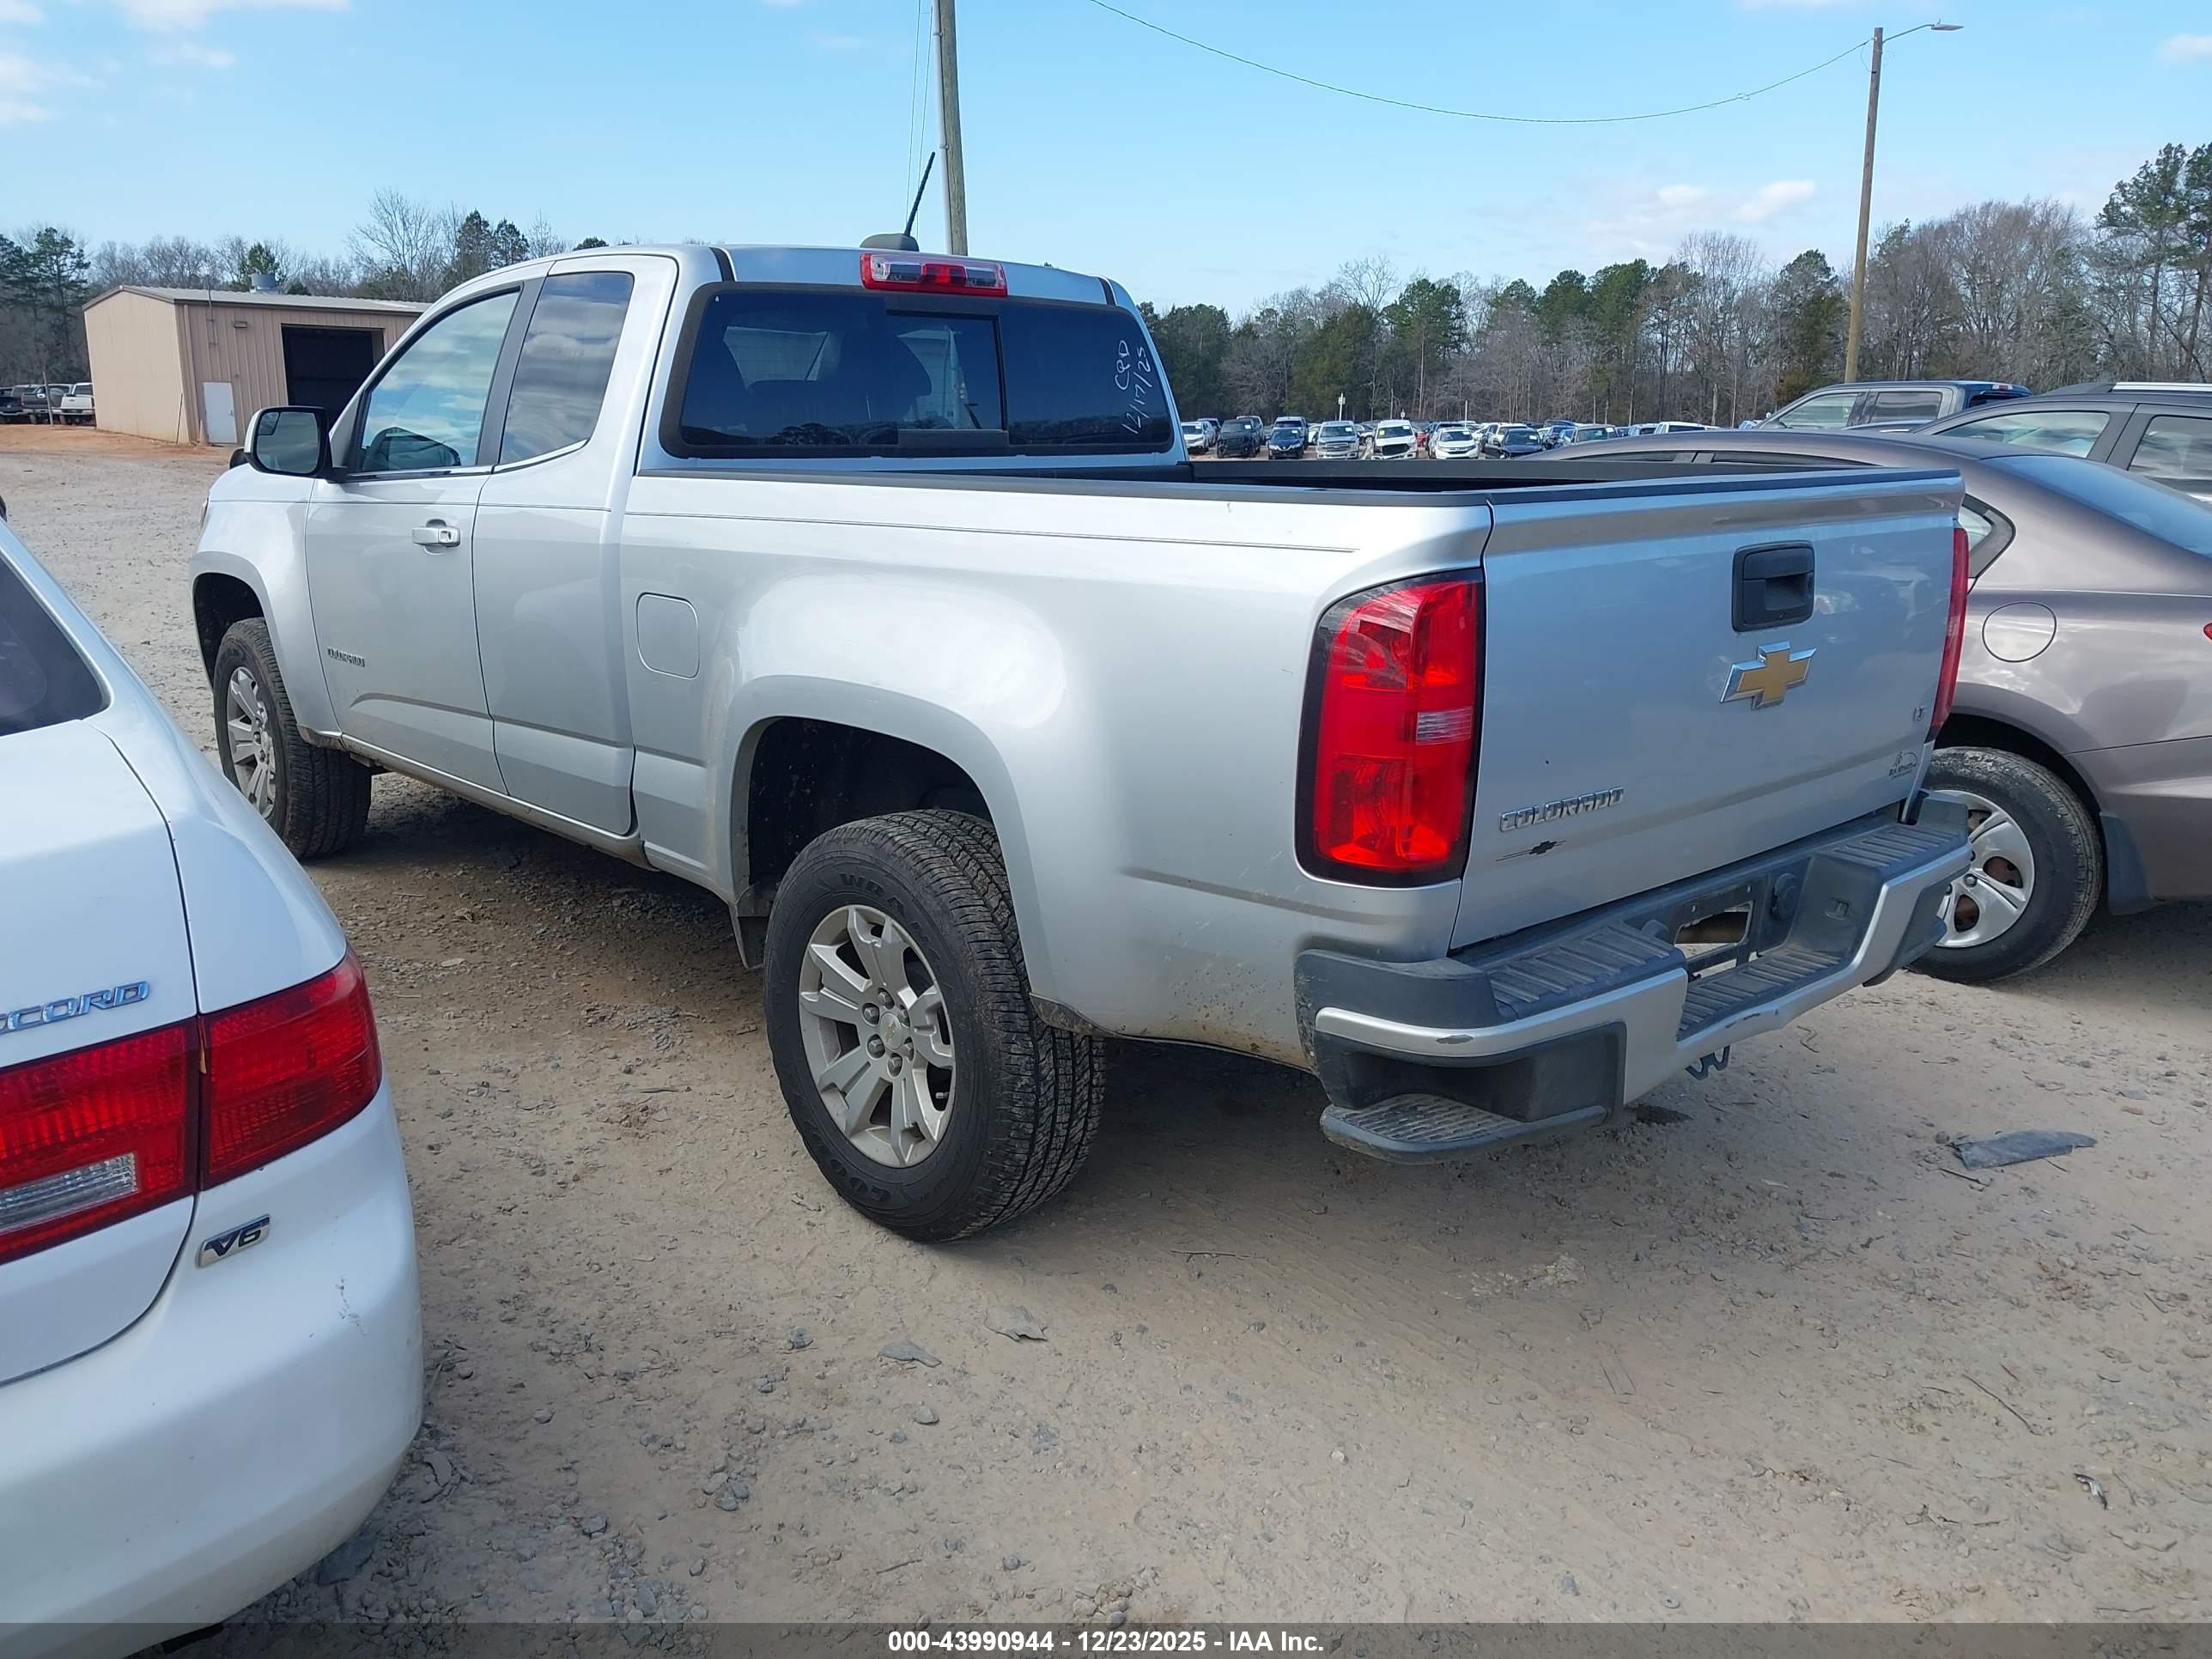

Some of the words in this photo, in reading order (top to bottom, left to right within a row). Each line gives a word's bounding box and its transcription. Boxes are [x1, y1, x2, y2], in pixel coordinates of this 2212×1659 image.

[1121, 345, 1152, 434] 12/17/25
[1500, 787, 1625, 832] COLORADO
[0, 981, 149, 1035] CORD
[204, 1220, 262, 1257] V6
